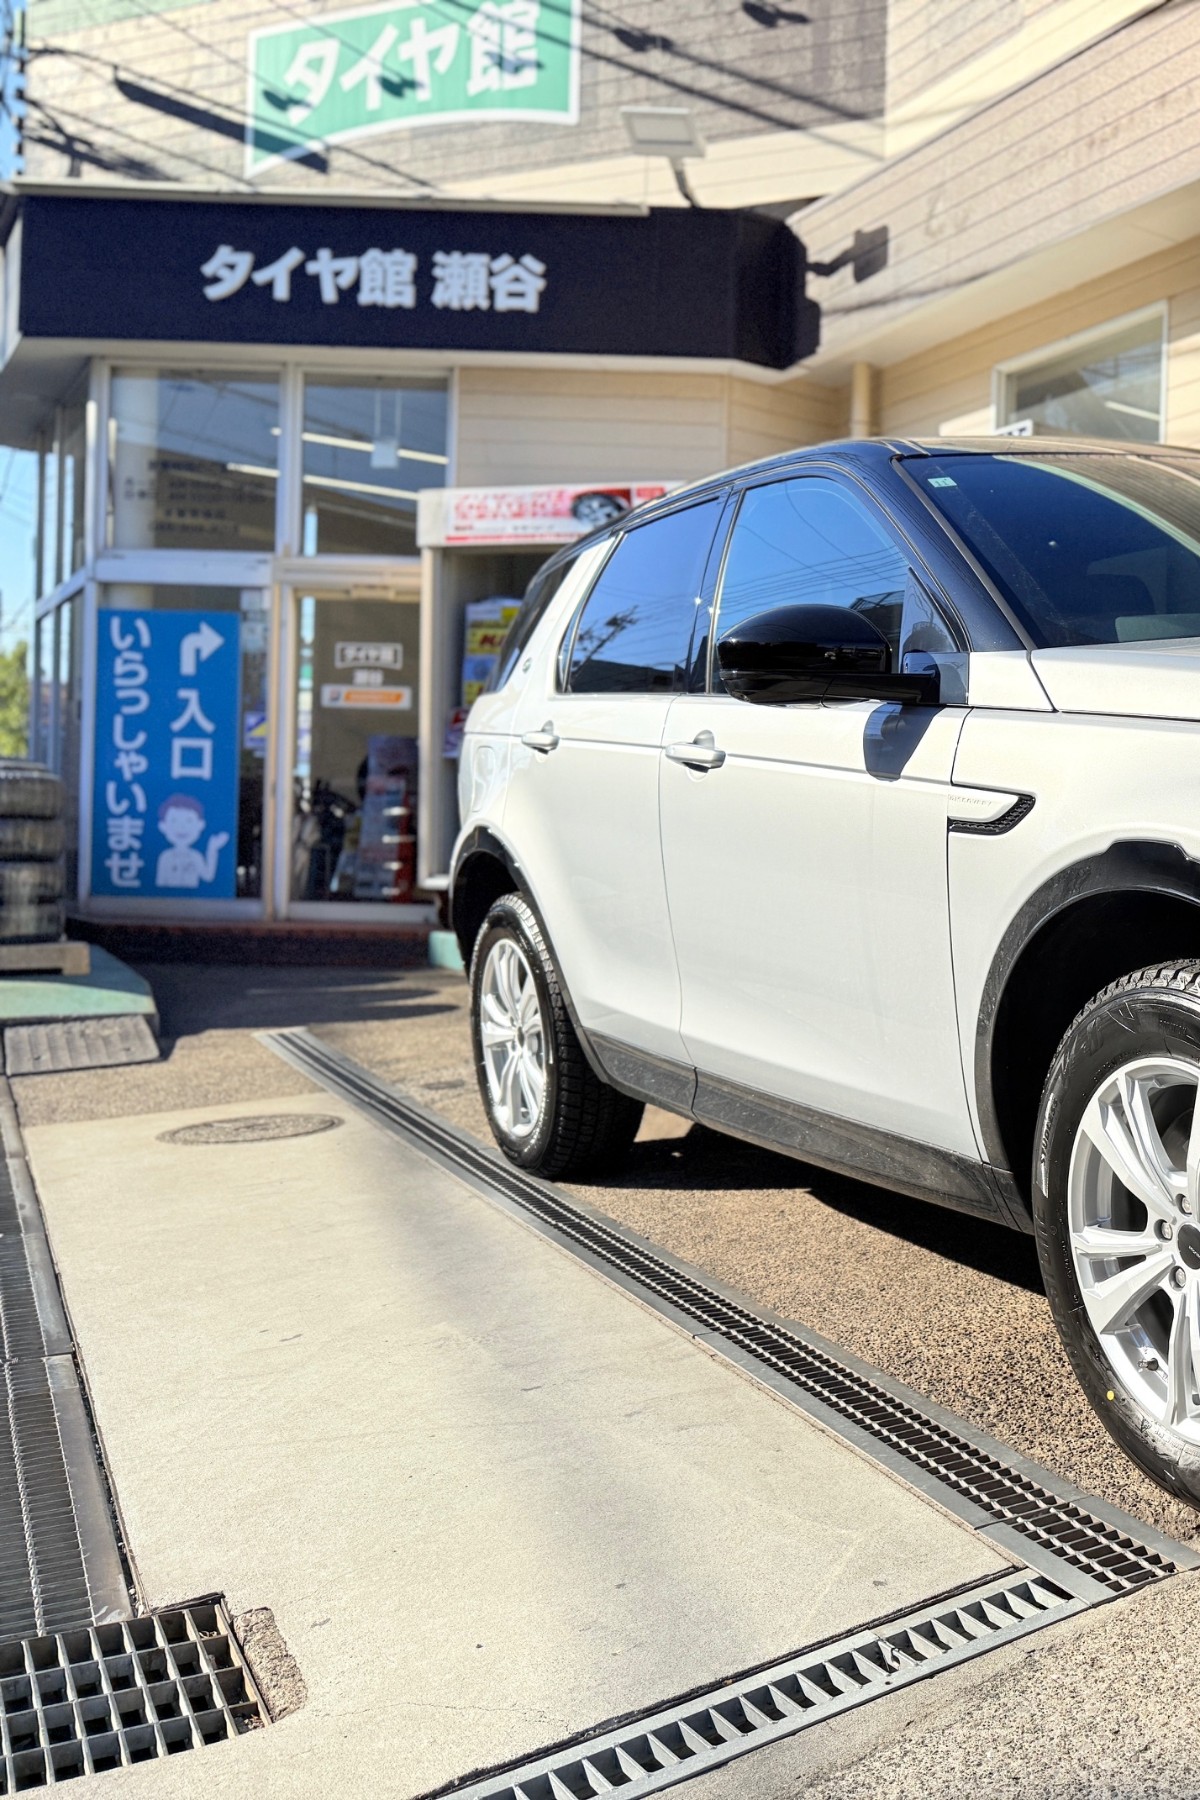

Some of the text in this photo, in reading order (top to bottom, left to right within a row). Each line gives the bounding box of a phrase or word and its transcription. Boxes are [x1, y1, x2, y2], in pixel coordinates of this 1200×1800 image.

[282, 0, 541, 126] タイヤ館
[200, 245, 547, 314] タイヤ館 瀬谷
[104, 615, 151, 889] いらっしゃいませ
[169, 688, 216, 781] 入口
